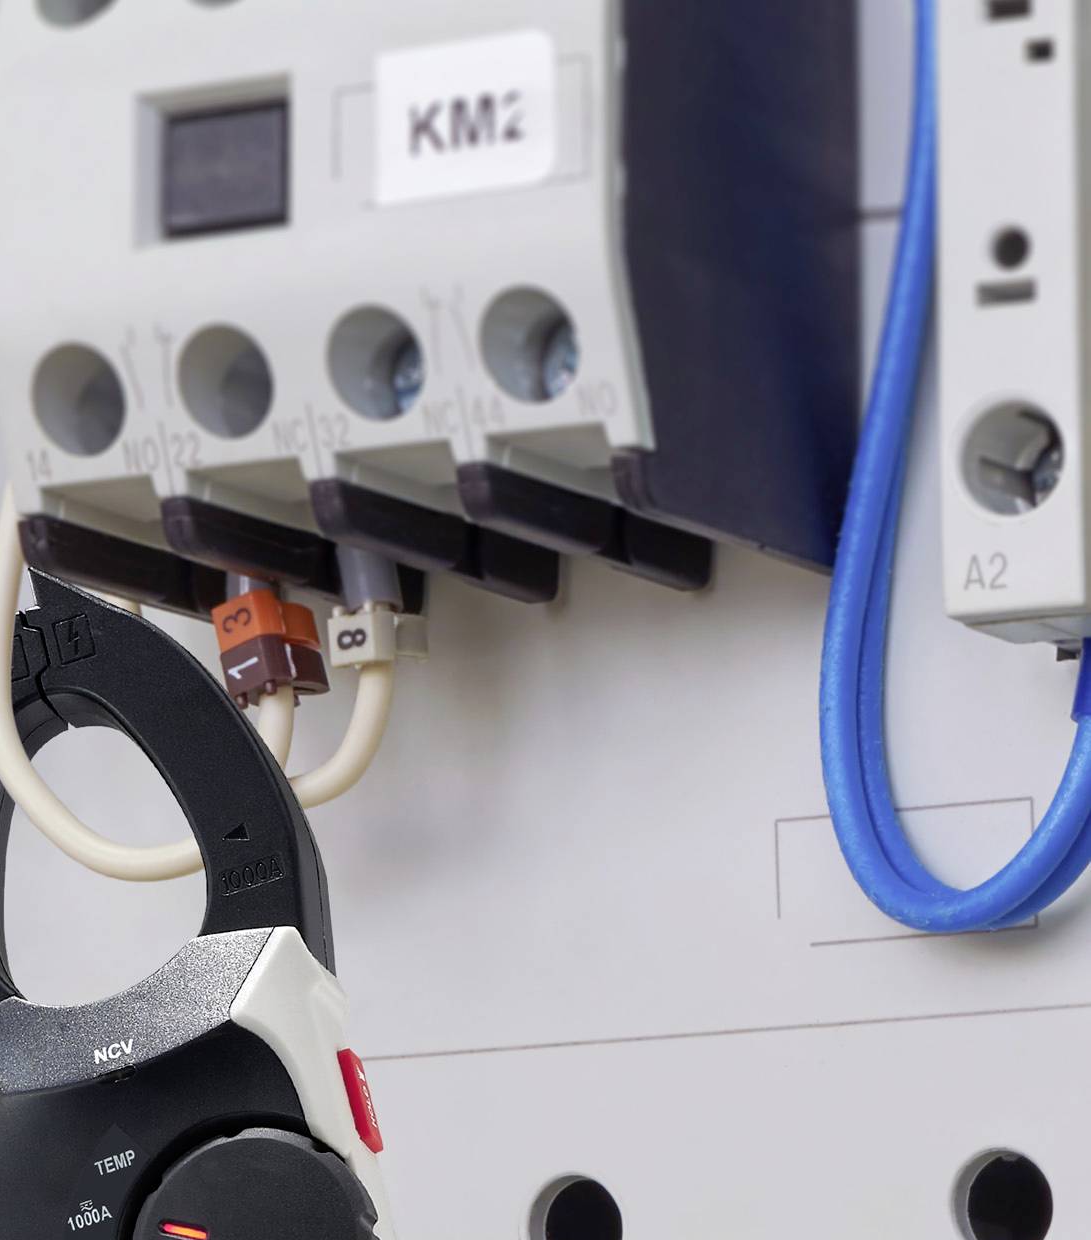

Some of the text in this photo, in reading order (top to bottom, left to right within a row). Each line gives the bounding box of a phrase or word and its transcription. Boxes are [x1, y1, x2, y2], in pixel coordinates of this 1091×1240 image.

[964, 551, 1007, 590] A2
[337, 628, 367, 650] 8
[221, 857, 284, 894] 1000A
[93, 1039, 134, 1064] NCV
[94, 1150, 135, 1176] TEMP
[67, 1205, 113, 1231] 1000A
